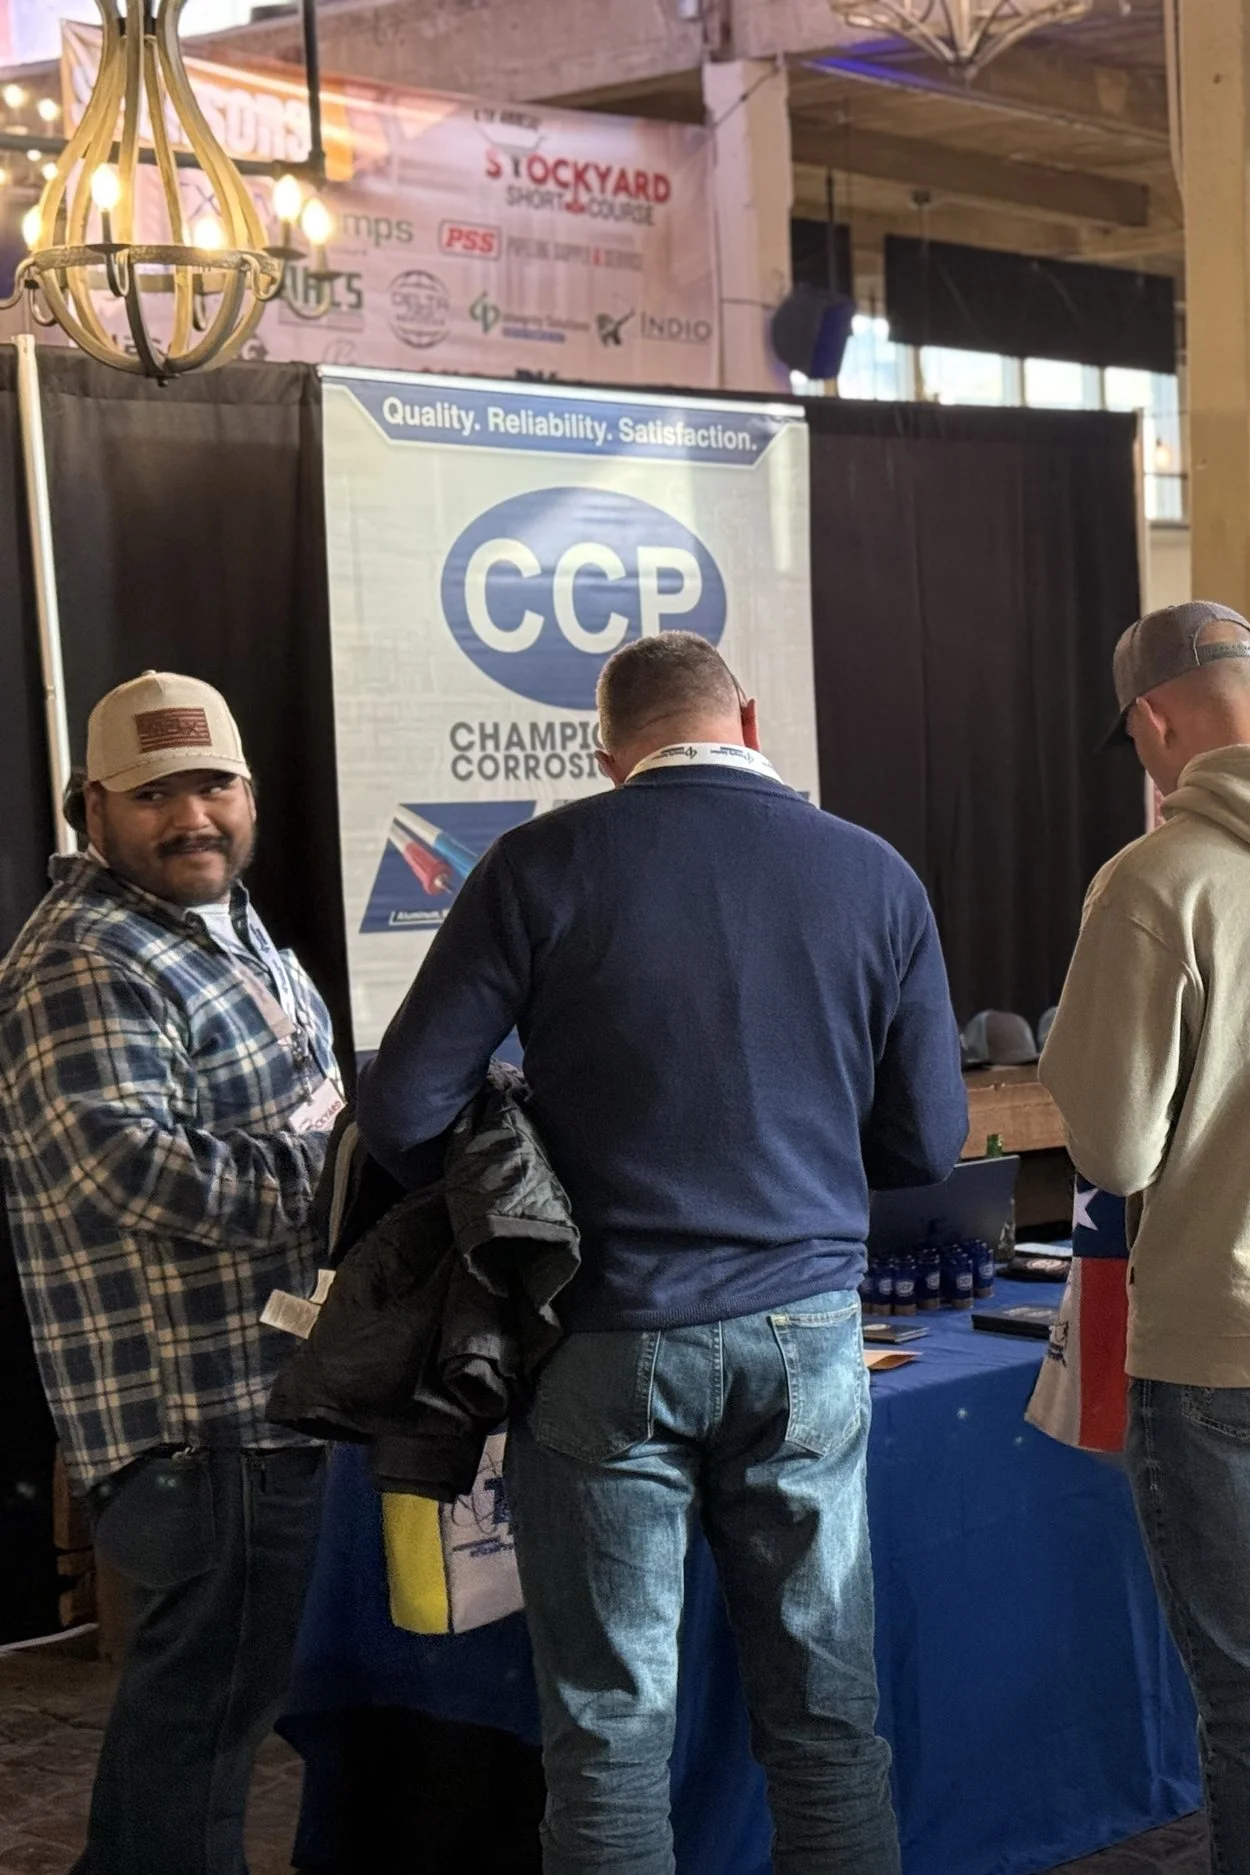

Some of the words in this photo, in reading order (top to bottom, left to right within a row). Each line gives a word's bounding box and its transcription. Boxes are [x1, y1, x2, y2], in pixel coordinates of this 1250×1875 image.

[485, 149, 671, 204] STOCKYARD
[507, 184, 564, 210] SHORT
[588, 196, 657, 226] COURSE
[446, 227, 496, 253] PSS
[641, 311, 714, 341] INDIO
[382, 396, 481, 437] Quality.
[487, 406, 613, 446] Reliability.
[618, 416, 757, 451] Satisfaction.
[464, 537, 703, 655] CCP
[451, 751, 606, 782] CORROSI
